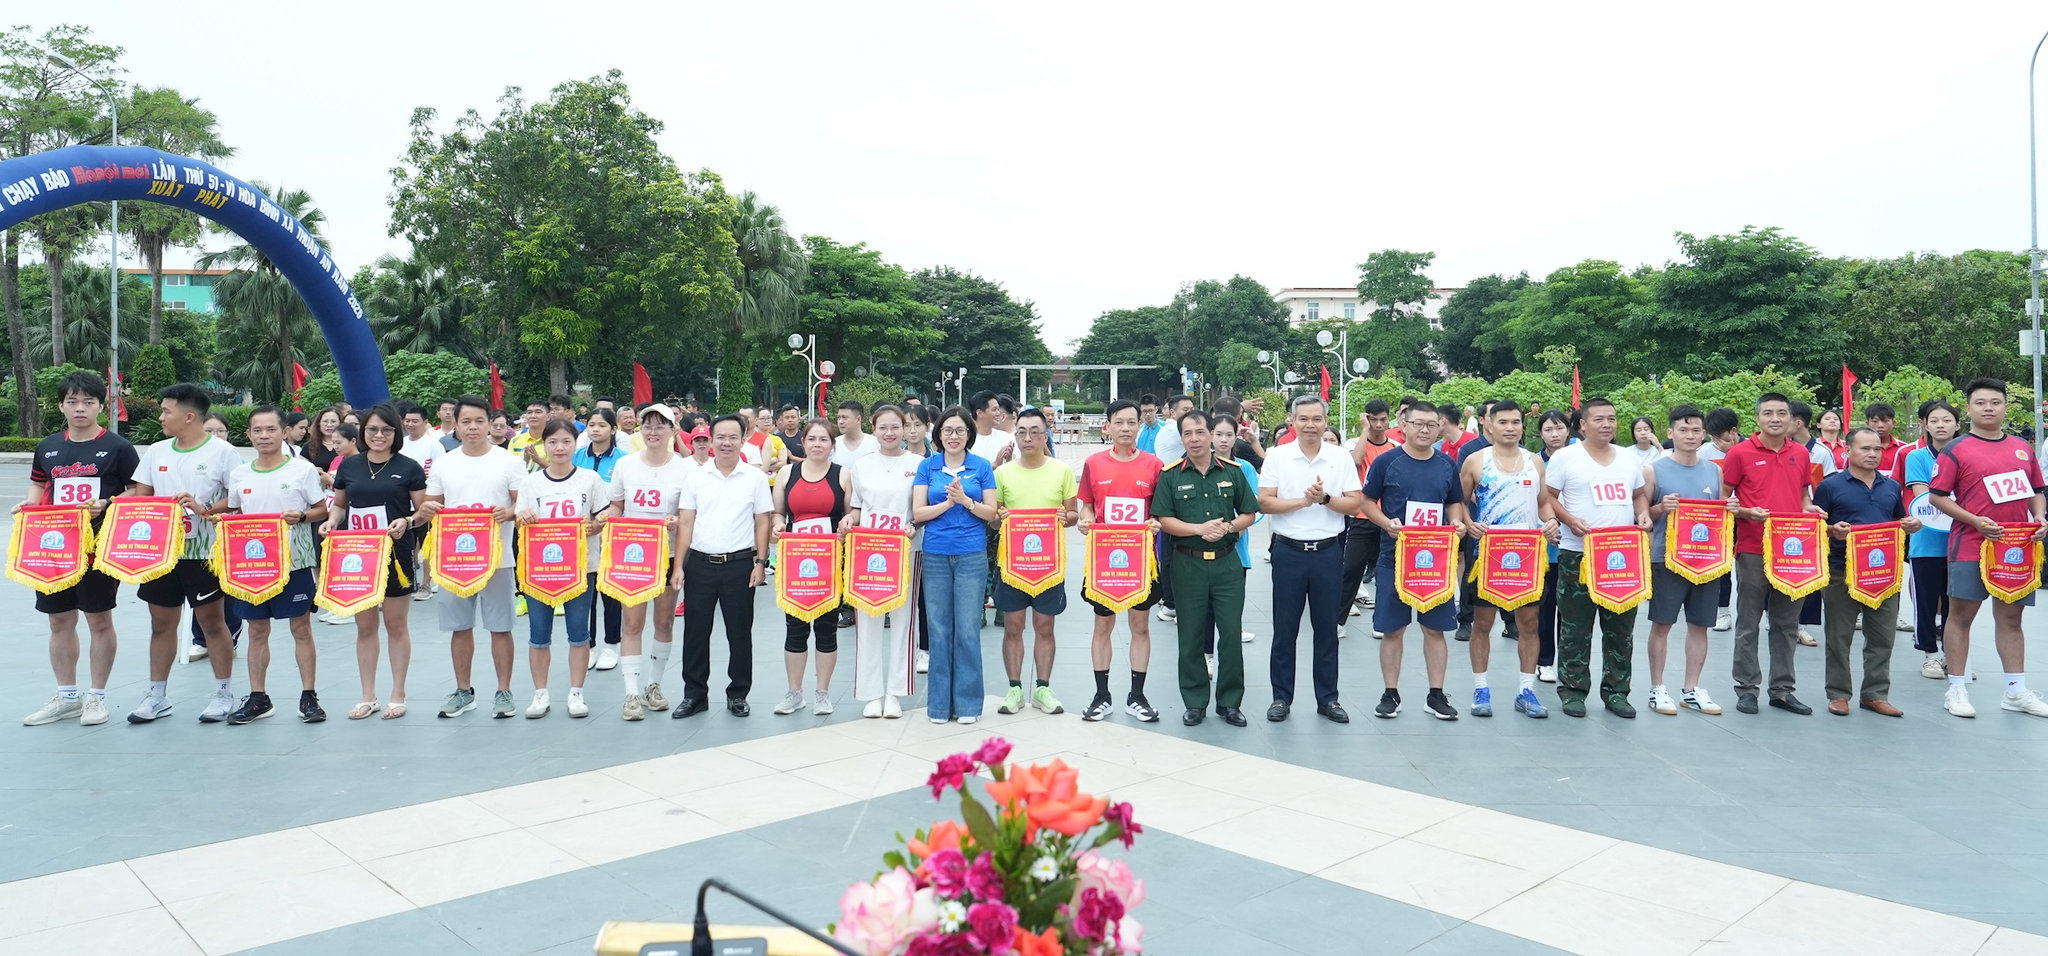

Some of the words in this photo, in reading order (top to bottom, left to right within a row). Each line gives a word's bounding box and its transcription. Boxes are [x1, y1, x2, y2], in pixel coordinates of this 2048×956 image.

[147, 180, 184, 198] XUẤT
[194, 188, 229, 210] PHÁT
[2, 176, 40, 206] CHẠY
[152, 158, 176, 182] LẦN
[238, 186, 257, 208] HÒA
[259, 198, 280, 223] BÌNH
[319, 254, 332, 272] AN
[60, 484, 92, 502] 38
[1594, 483, 1626, 501] 105
[1990, 477, 2028, 498] 124
[632, 489, 662, 508] 43
[546, 499, 576, 518] 76
[1110, 503, 1138, 522] 52
[1412, 508, 1438, 526] 45
[351, 514, 378, 530] 90
[869, 513, 901, 530] 128
